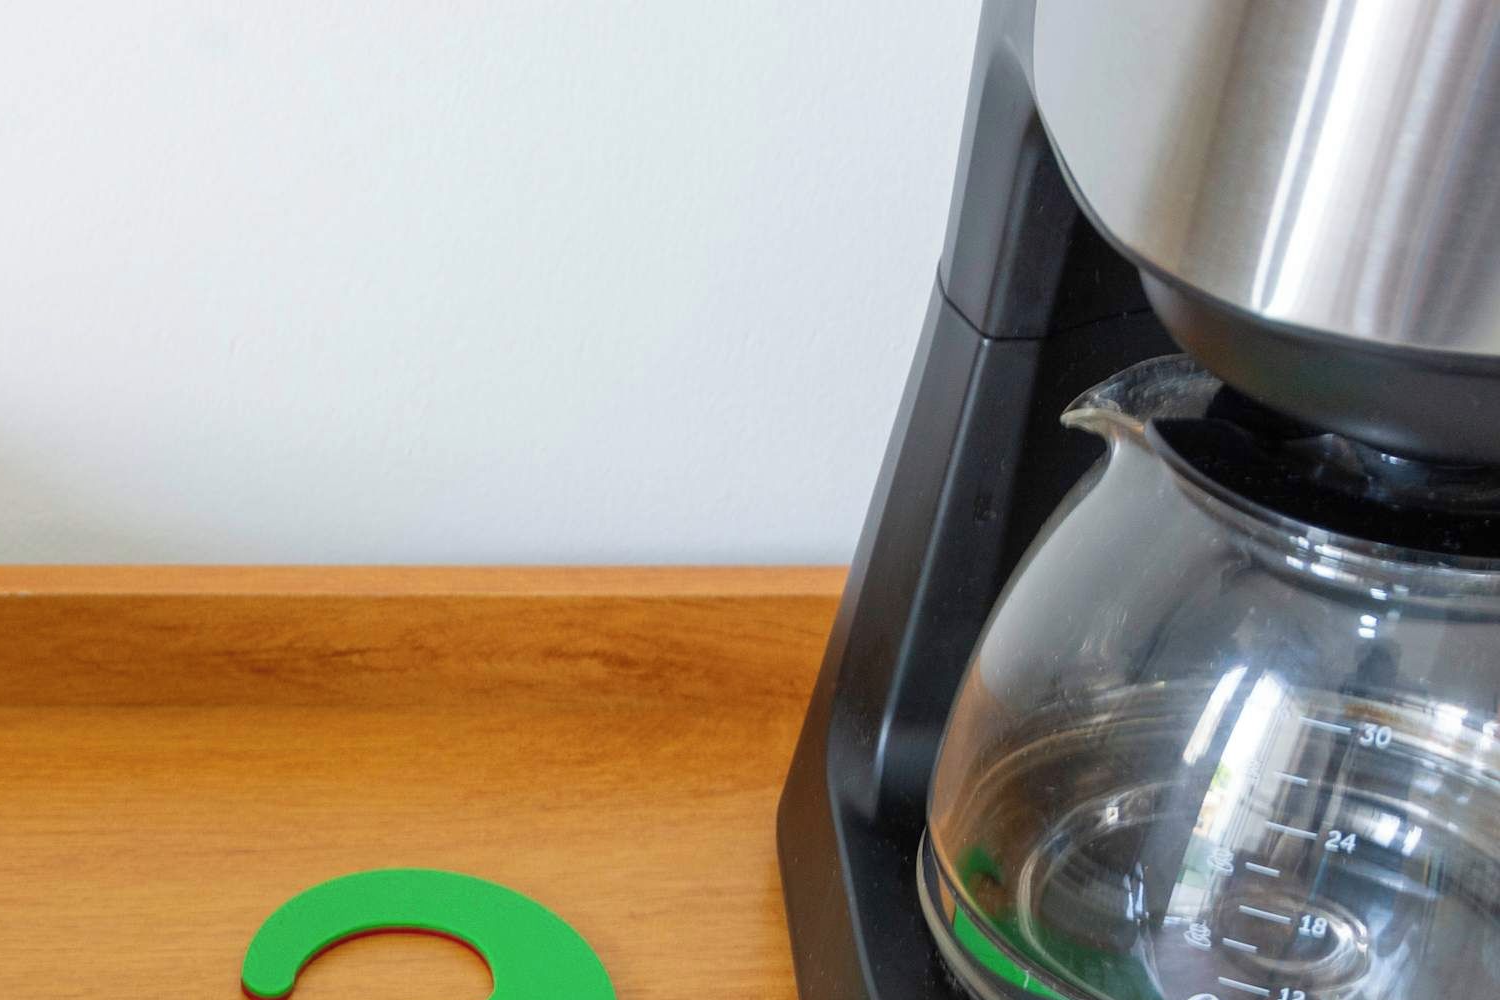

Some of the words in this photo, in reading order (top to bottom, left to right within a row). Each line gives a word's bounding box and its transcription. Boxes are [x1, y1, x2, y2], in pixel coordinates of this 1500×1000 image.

[1359, 723, 1392, 749] 30
[1324, 830, 1357, 855] 24
[1301, 915, 1327, 938] 18
